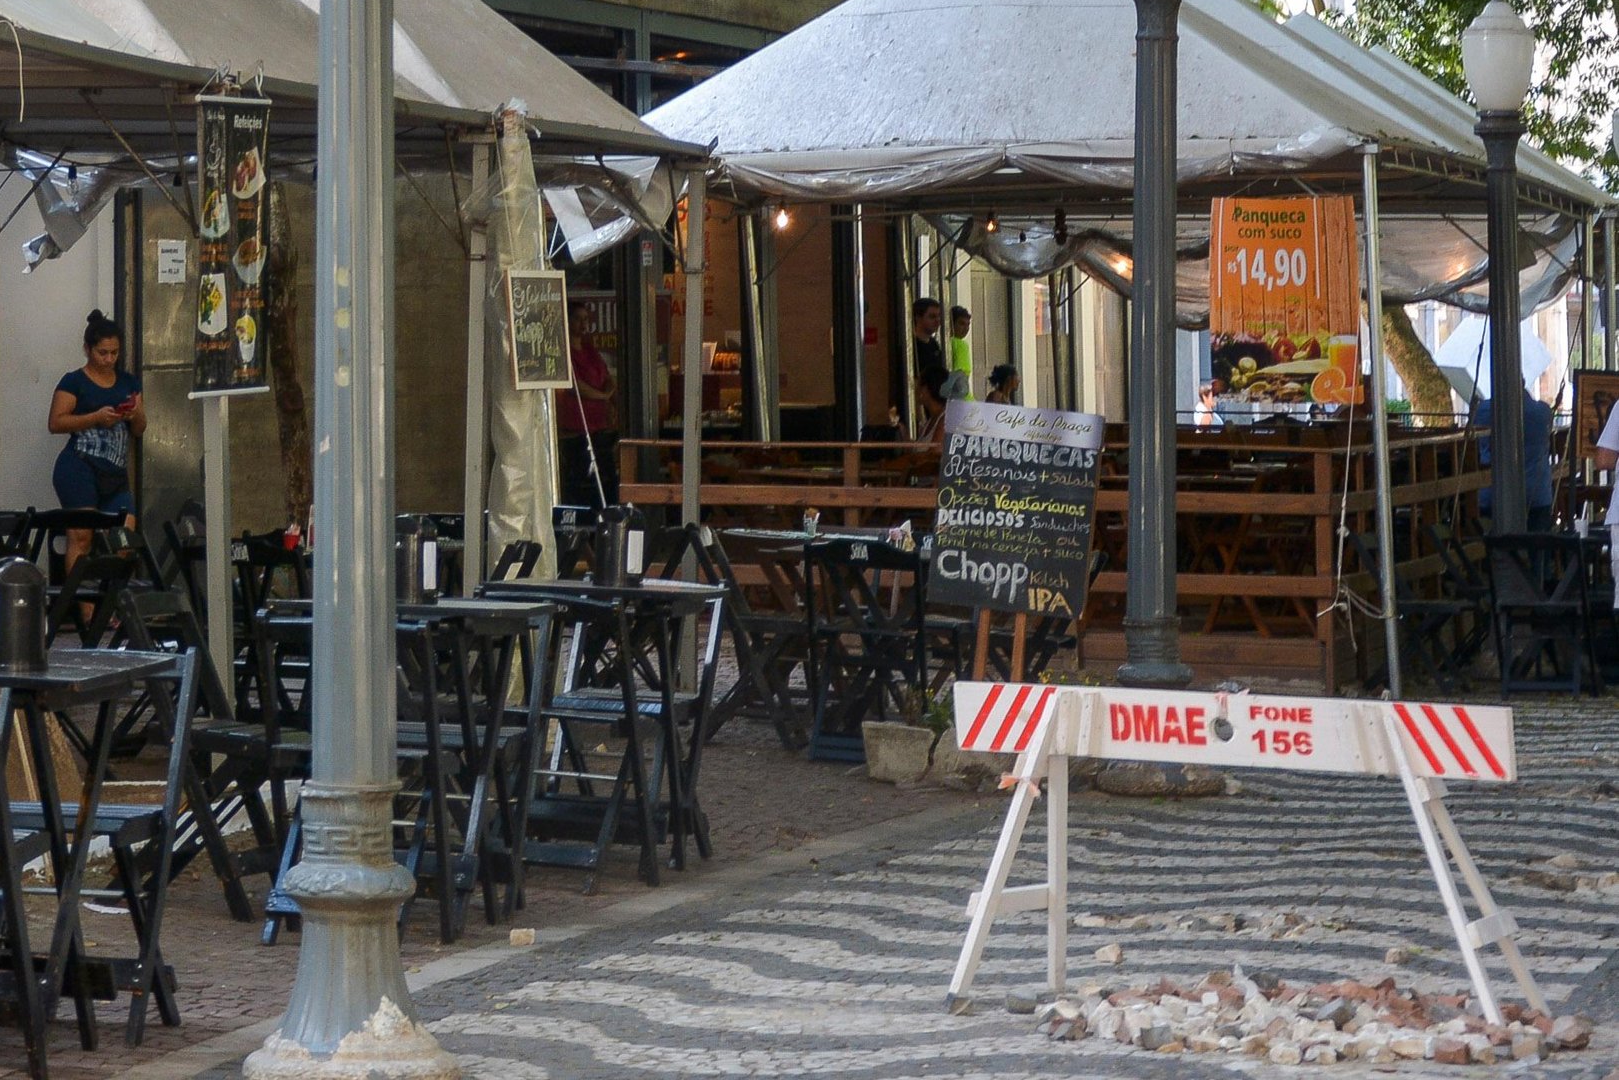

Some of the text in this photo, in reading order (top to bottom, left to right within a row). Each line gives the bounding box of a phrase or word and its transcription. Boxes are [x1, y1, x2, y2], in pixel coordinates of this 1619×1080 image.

[1233, 206, 1306, 227] Panqueca
[1238, 226, 1302, 239] com suco
[1236, 247, 1308, 292] 14,90
[994, 409, 1092, 435] Café da Praça
[948, 433, 1098, 469] PANQUECAS
[994, 493, 1087, 517] Vegetarianas
[937, 549, 1029, 605] Chopp
[1027, 588, 1074, 617] IPA
[1109, 703, 1207, 746] DMAE
[1249, 705, 1313, 724] FONE
[1251, 728, 1314, 756] 156
